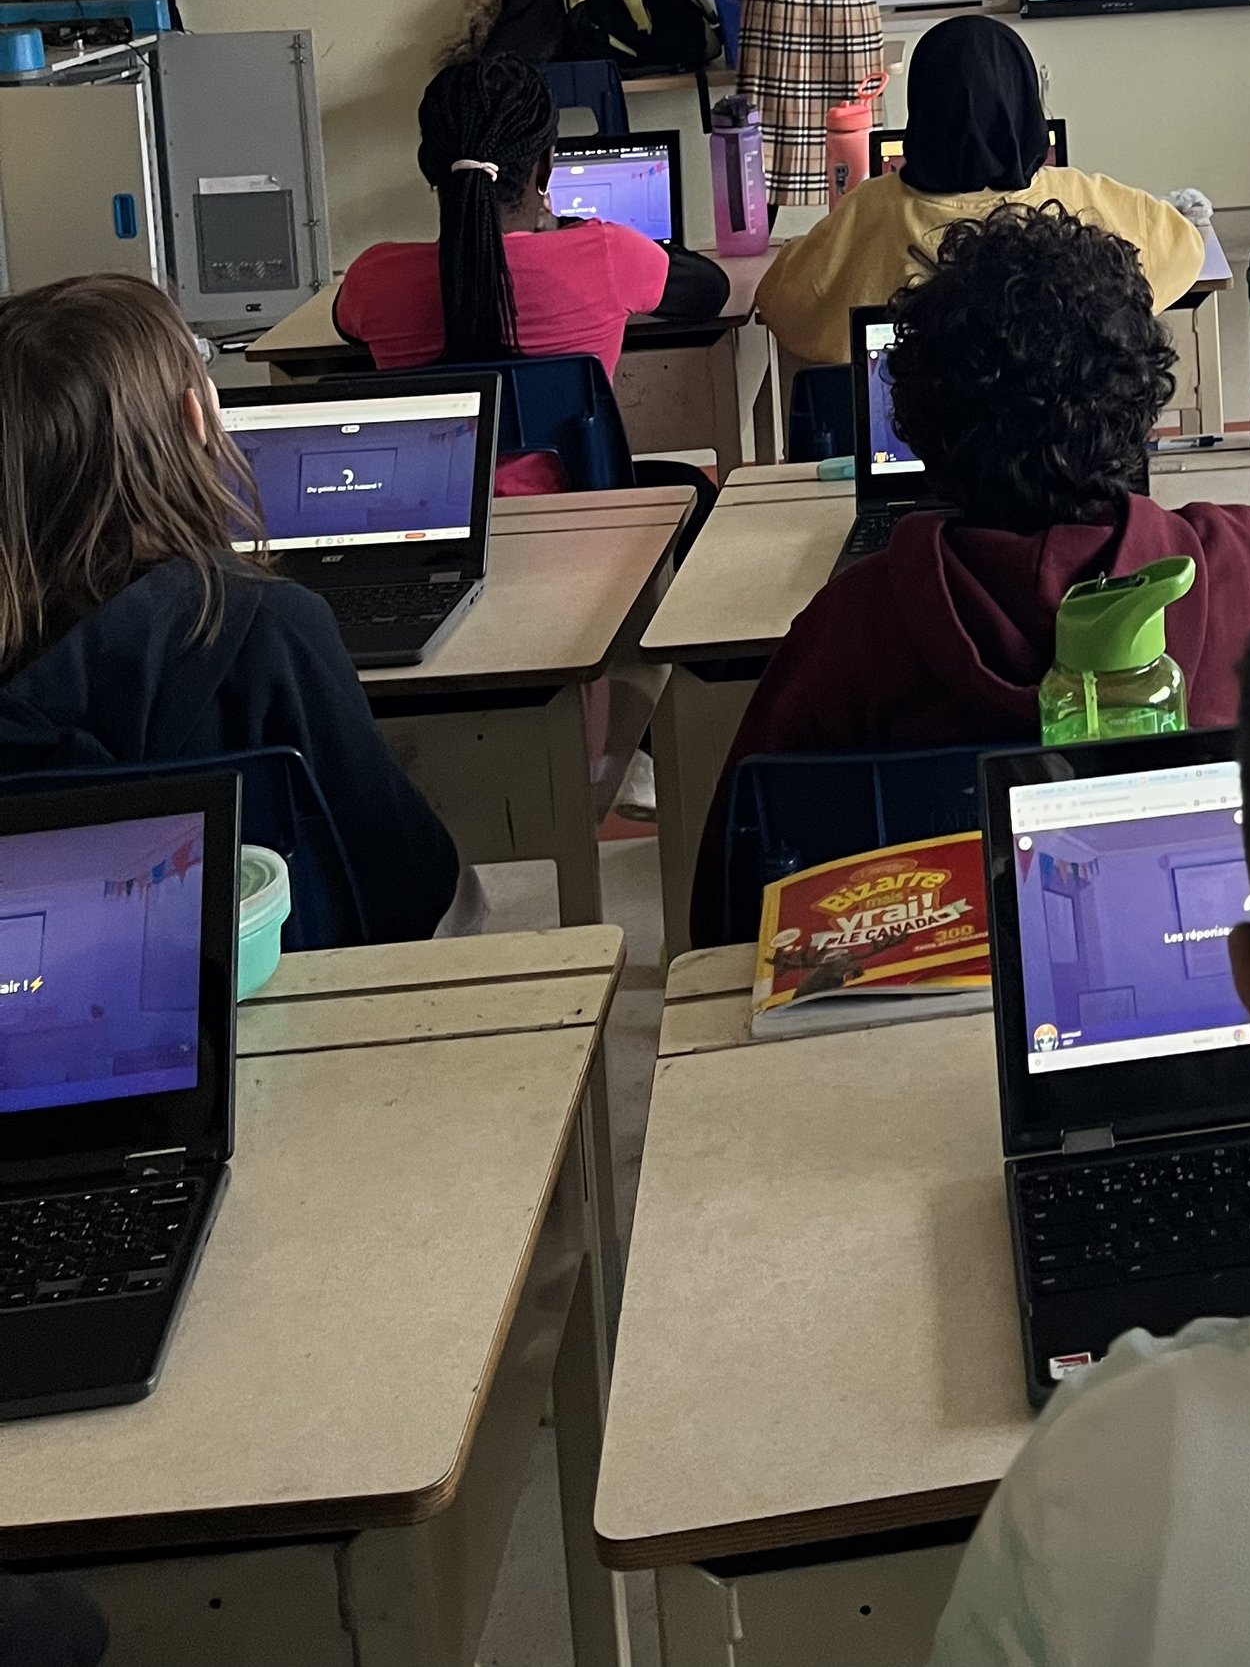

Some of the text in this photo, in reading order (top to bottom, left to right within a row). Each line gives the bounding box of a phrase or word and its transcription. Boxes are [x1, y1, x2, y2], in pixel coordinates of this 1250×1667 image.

[321, 555, 344, 563] acer
[818, 871, 946, 913] Bizarre
[836, 892, 934, 933] vrai!
[838, 931, 861, 945] LE
[865, 916, 939, 940] CANADA
[935, 924, 975, 943] 300
[1164, 927, 1233, 944] Les réponse
